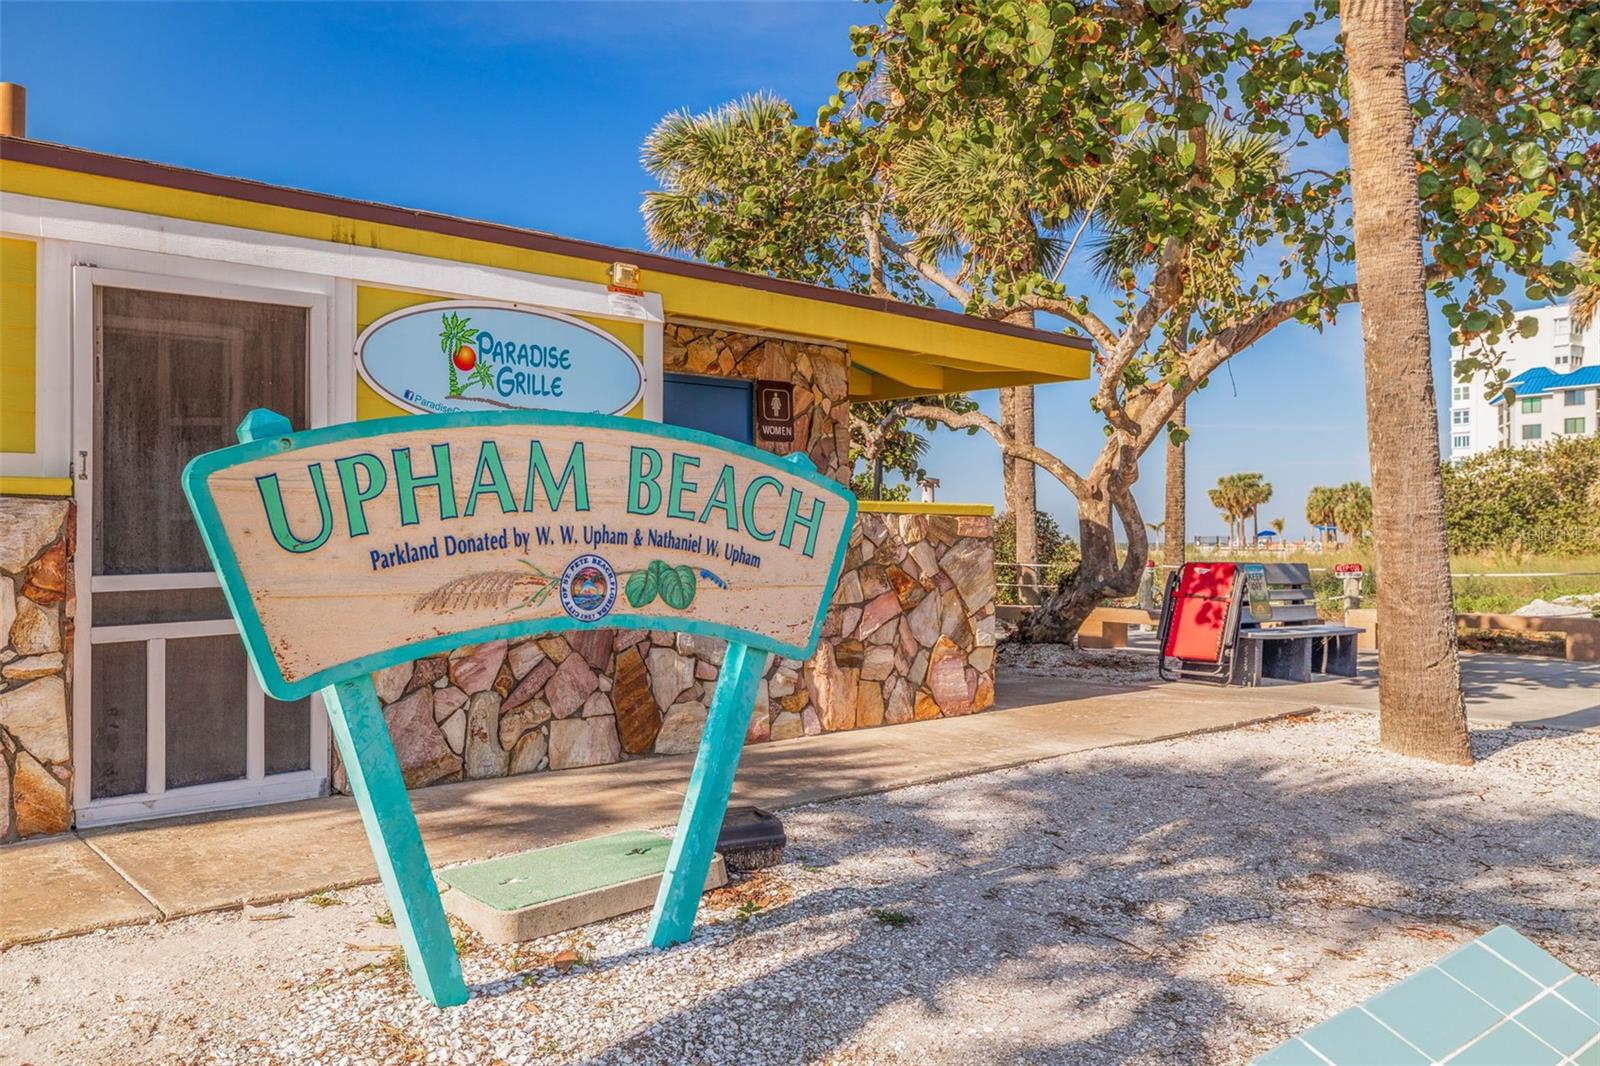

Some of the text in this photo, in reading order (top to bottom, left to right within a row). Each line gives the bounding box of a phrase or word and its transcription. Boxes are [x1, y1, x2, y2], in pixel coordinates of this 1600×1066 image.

[476, 331, 571, 370] PARADISE
[496, 366, 563, 397] GRILLE
[762, 425, 792, 436] WOMEN
[255, 440, 826, 559] UPHAM BEACH
[370, 524, 762, 571] Parkland Donated by W. W. Upham & Nathaniel W. Upham
[570, 558, 589, 571] PETE
[562, 586, 569, 599] OF
[564, 601, 580, 617] CITY
